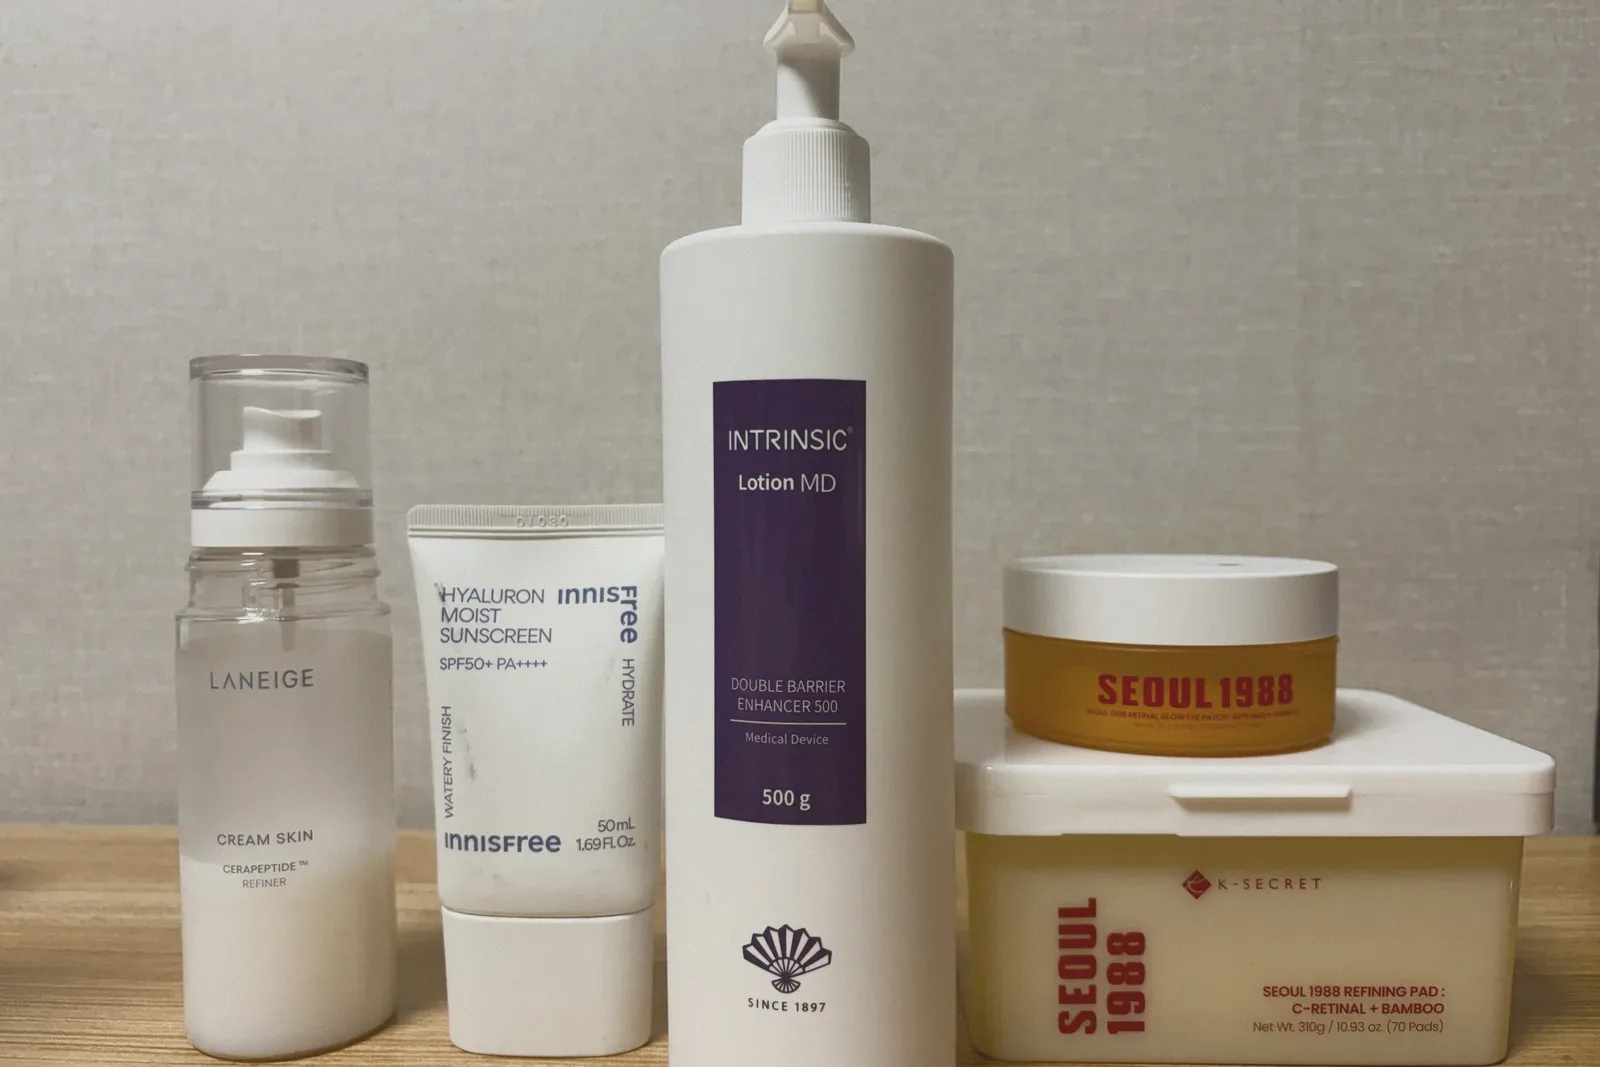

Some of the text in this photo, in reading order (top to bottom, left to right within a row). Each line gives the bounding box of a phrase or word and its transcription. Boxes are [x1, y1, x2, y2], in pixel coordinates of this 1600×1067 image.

[738, 472, 837, 493] Lotion MD
[440, 587, 545, 605] HYALURON
[440, 607, 501, 624] MOIST
[440, 627, 552, 644] SUNSCREEN
[440, 657, 548, 671] SPF50+ PA++++
[210, 668, 314, 690] LANEIGE
[731, 677, 846, 693] DOUBLE BARRIER
[621, 658, 636, 727] HYDRATE
[1097, 674, 1294, 709] SEOUL 1988
[737, 697, 838, 713] ENHANCER 500
[745, 732, 829, 745] Medical Device
[441, 705, 455, 819] WATERY FINISH
[762, 788, 811, 811] 500 g
[216, 829, 314, 847] CREAM SKIN
[222, 861, 297, 874] CERAPEPTIDE
[242, 877, 287, 889] REFINER
[1217, 877, 1322, 890] K-SECRET
[1057, 897, 1098, 1036] SEOUL
[1106, 931, 1146, 1035] 1988
[1262, 985, 1306, 998] SEOUL
[1309, 985, 1341, 998] 1988
[1344, 985, 1407, 998] REFINING
[1410, 985, 1439, 998] PAD
[747, 997, 826, 1013] SINCE 1897
[1291, 1002, 1445, 1015] C-RETINAL + BAMBOO
[1253, 1019, 1445, 1036] Net Wt. 310g / 10.93 oz. (70 Pads)
